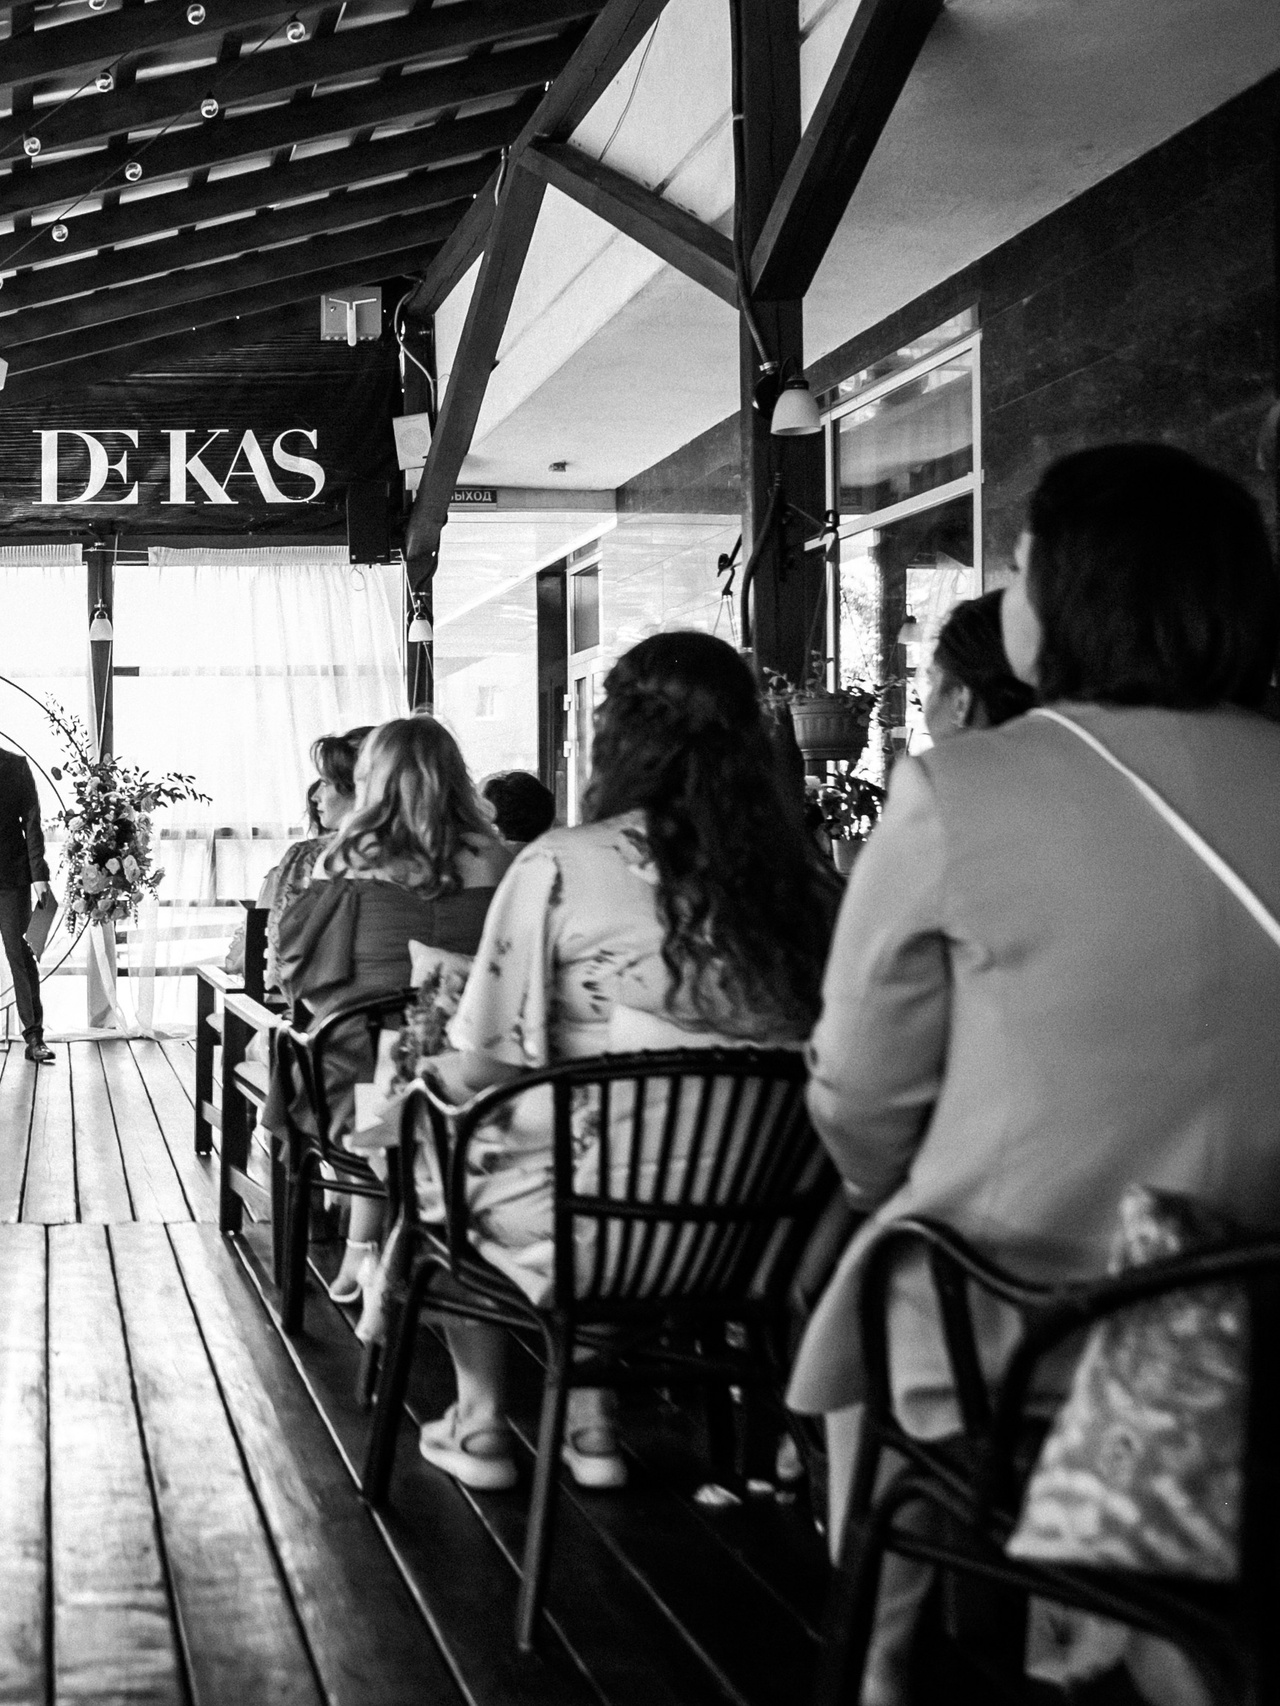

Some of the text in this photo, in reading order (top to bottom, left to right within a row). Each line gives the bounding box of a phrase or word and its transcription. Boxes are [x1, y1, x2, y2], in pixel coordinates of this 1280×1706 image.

[32, 429, 326, 505] DE KAS
[451, 490, 493, 502] ЫХОД
